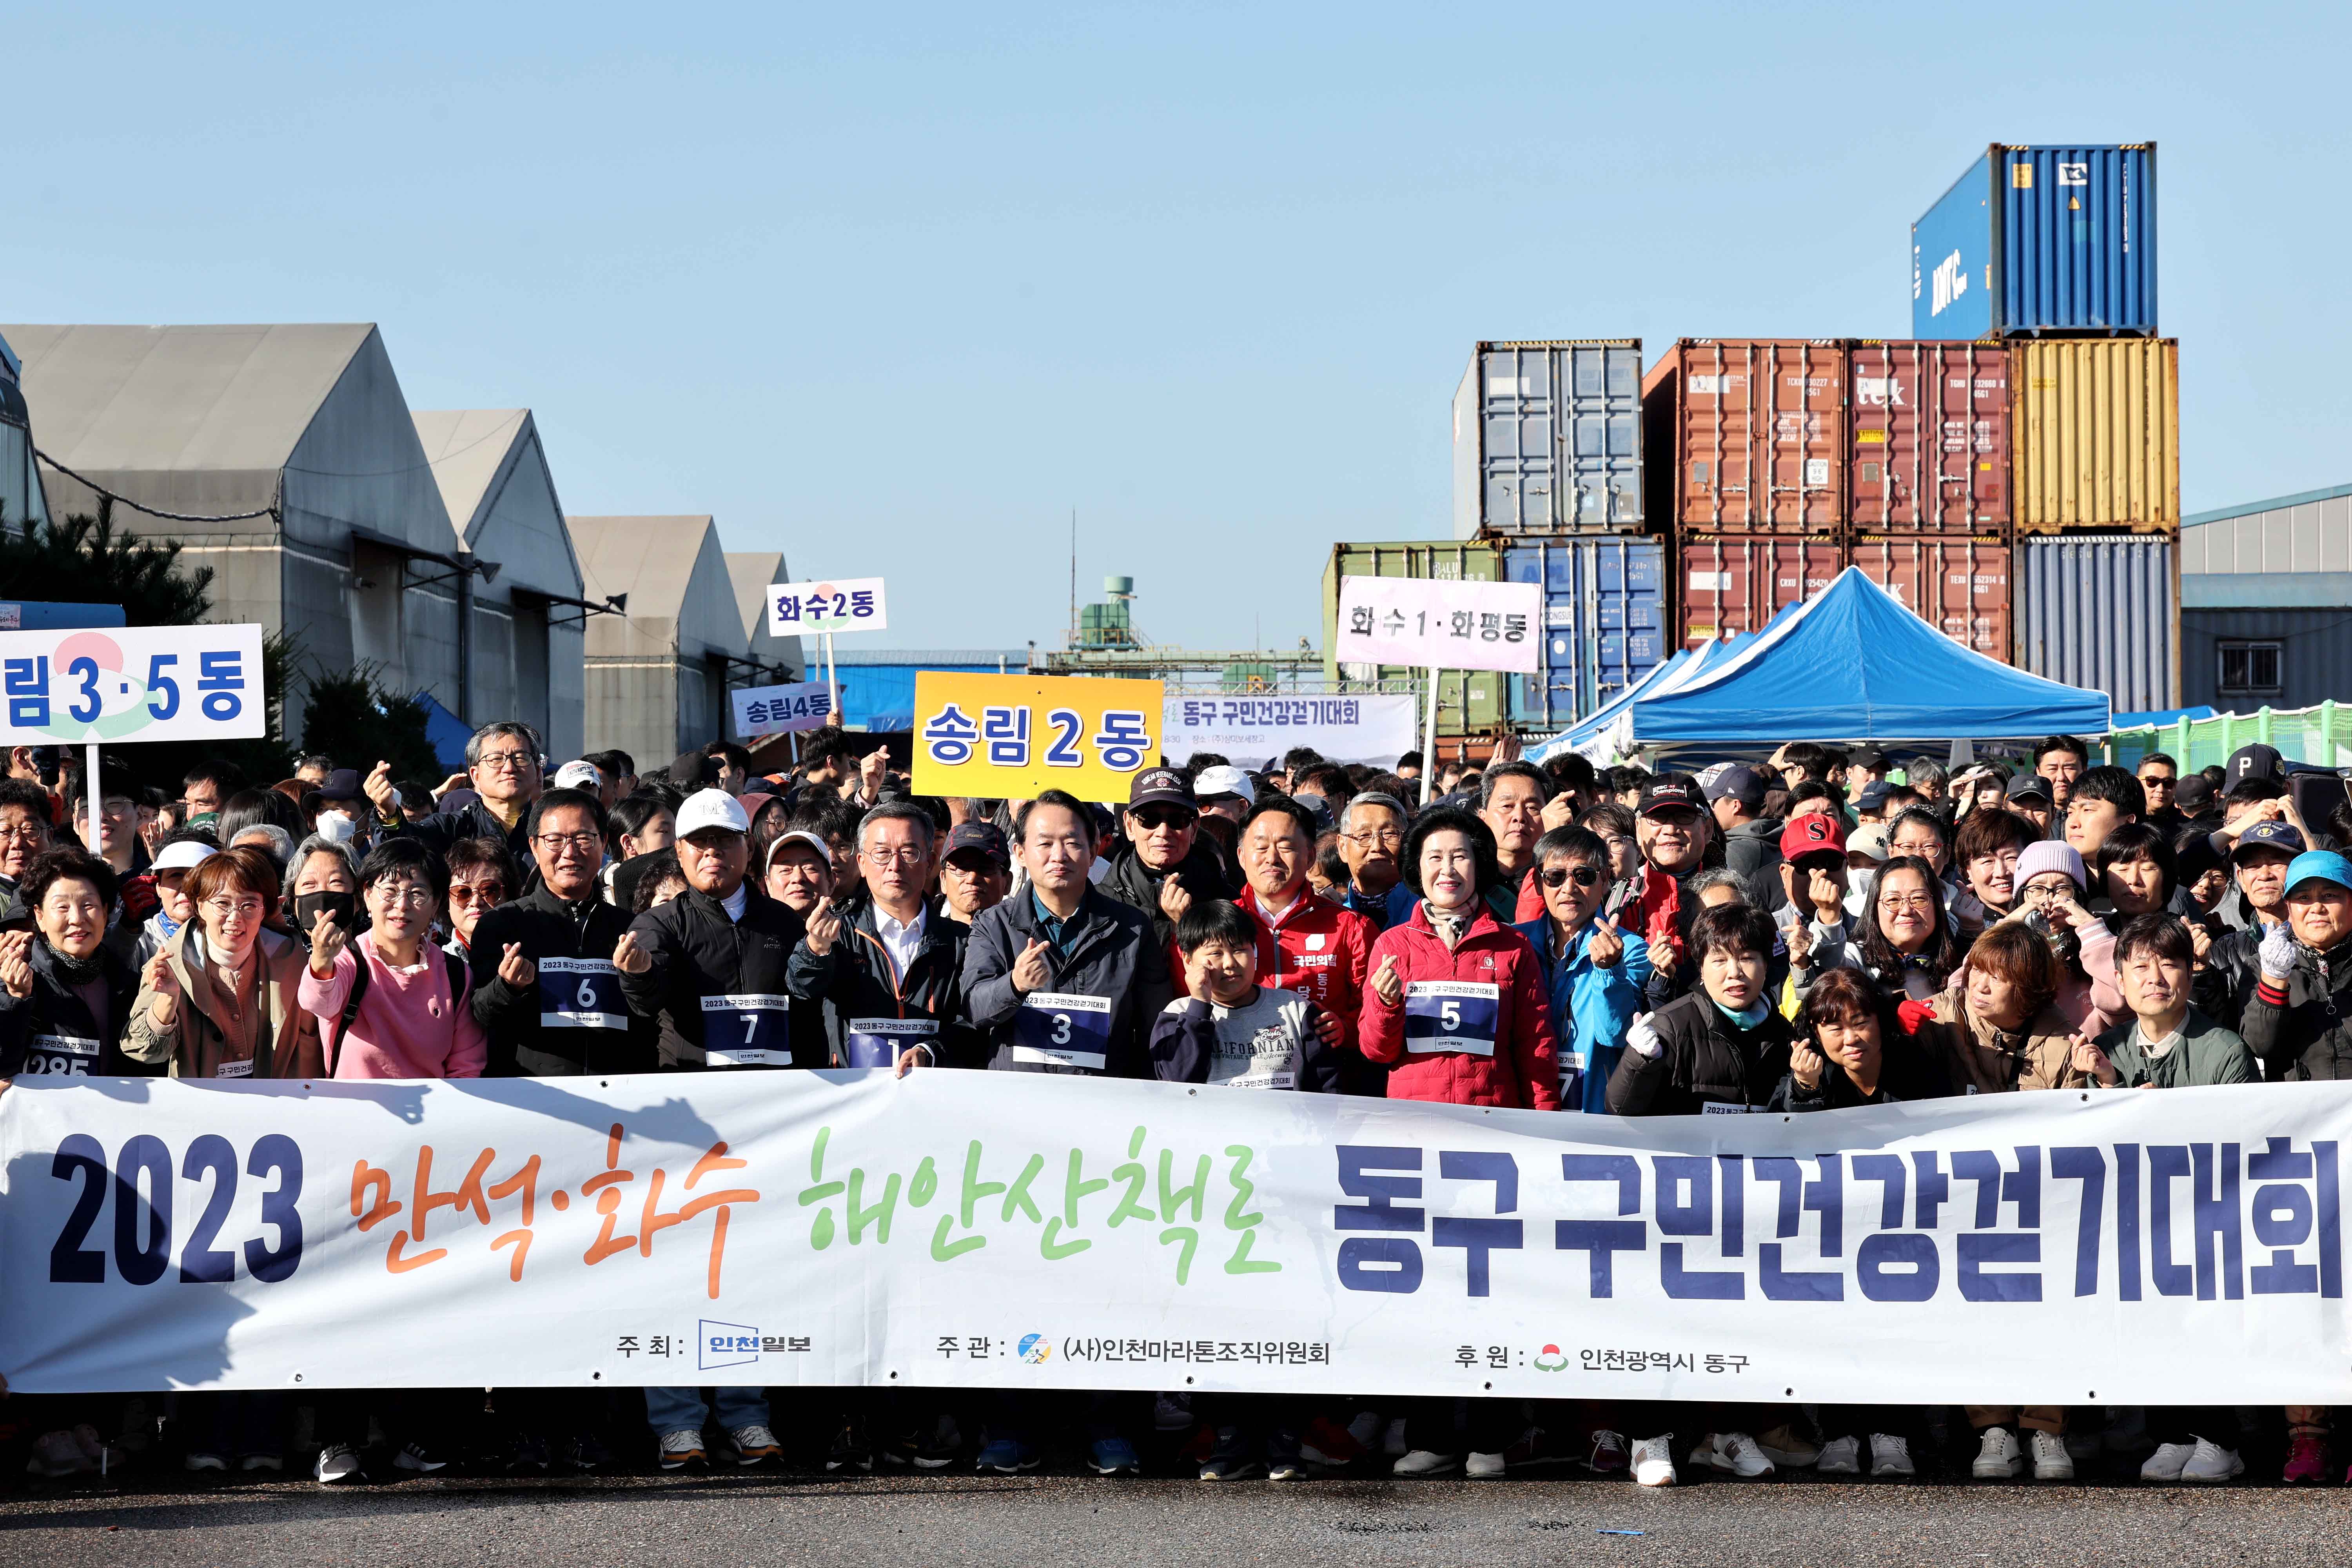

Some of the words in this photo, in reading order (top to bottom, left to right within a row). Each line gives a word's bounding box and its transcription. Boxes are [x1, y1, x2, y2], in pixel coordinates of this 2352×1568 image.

[1950, 575, 1966, 584] TEXU
[777, 590, 874, 622] 화수2동
[746, 693, 831, 724] 송림4동
[1183, 701, 1217, 726] 동구
[1223, 699, 1359, 726] 구민건강걷기대회
[2239, 757, 2252, 777] P
[1141, 772, 1156, 785] KOREAN
[1155, 771, 1173, 780] VETERANS
[1652, 788, 1685, 797] Champions
[1808, 822, 1826, 841] S
[1876, 836, 1886, 848] NY
[574, 962, 616, 972] 구민건강걷기대
[1293, 954, 1337, 967] 국민의힘
[577, 978, 596, 1008] 6
[1409, 985, 1427, 994] 2023
[1441, 985, 1495, 996] 구민건강걷기대회
[737, 998, 784, 1007] 구민건강걷기대회
[1039, 997, 1053, 1005] 동구
[1053, 998, 1106, 1009] 구민건강걷기대회
[1440, 1001, 1460, 1031] 5
[739, 1014, 758, 1044] 7
[885, 1023, 935, 1032] 구민건강걷기대회
[1051, 1013, 1071, 1044] 3
[1256, 1028, 1281, 1039] Brights
[44, 1040, 95, 1052] 구민건강걷기대회
[1211, 1038, 1295, 1054] ALIFORNIAN
[1243, 1077, 1290, 1087] 구민건강걷기대회
[1707, 1106, 1725, 1114] 2023
[50, 1133, 303, 1285] 2023
[798, 1125, 1282, 1286] 해안산책로
[1334, 1145, 1523, 1298] 동구
[1555, 1137, 2343, 1302] 구민건강걷기대회
[710, 1336, 811, 1353] 인천일보
[1063, 1336, 1330, 1366] (사)인천마라톤조직위원회
[1579, 1349, 1695, 1373] 인천광역시
[1704, 1353, 1750, 1373] 동구
